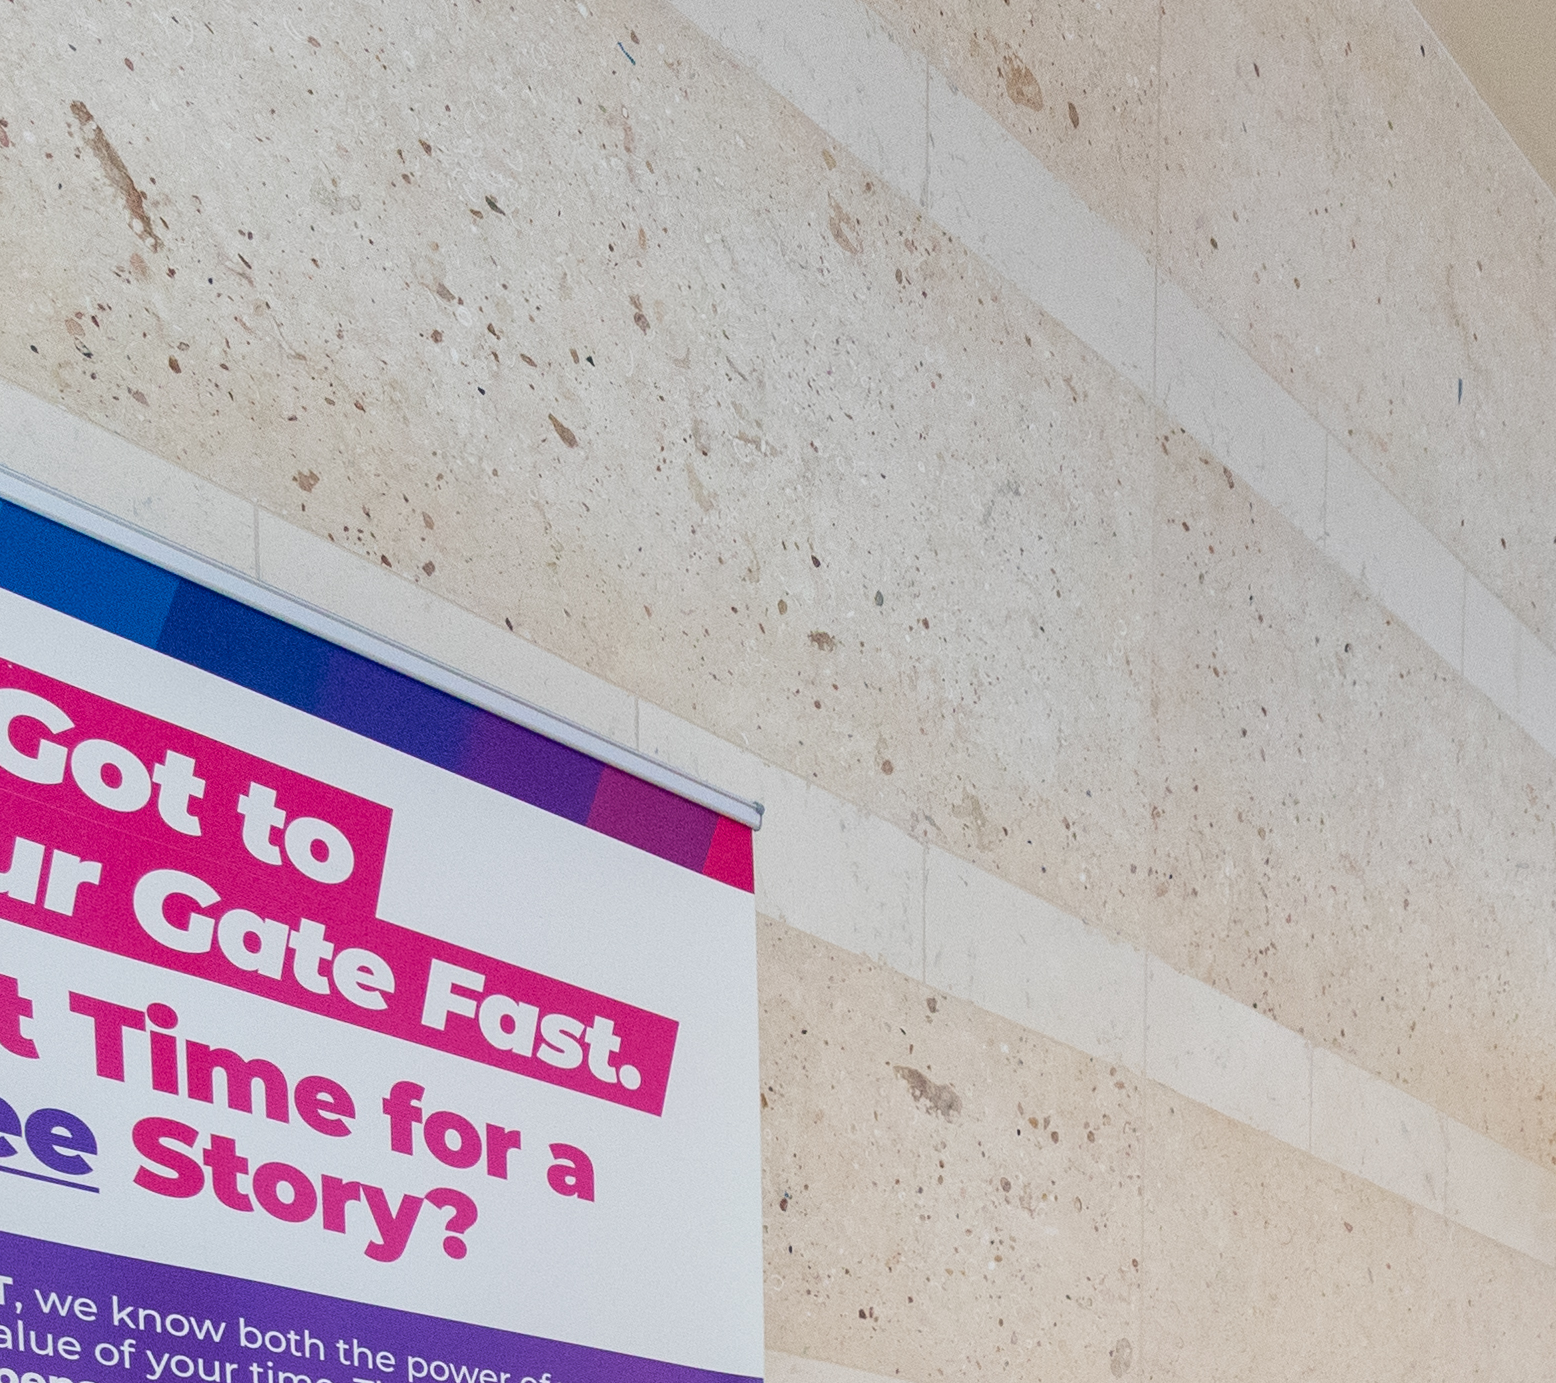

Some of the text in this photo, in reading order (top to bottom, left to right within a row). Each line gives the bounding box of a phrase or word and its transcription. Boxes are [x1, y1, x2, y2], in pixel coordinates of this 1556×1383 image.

[238, 782, 354, 883] to
[134, 869, 395, 1010] Gate
[421, 960, 647, 1091] Fast.
[69, 991, 355, 1137] Time
[383, 1081, 521, 1179] for
[547, 1143, 594, 1202] a
[132, 1111, 482, 1262] Story?
[35, 1289, 97, 1321] we
[112, 1295, 226, 1342] know
[239, 1318, 324, 1360] both
[336, 1339, 395, 1372] the
[95, 1339, 136, 1368] of
[146, 1346, 239, 1383] your
